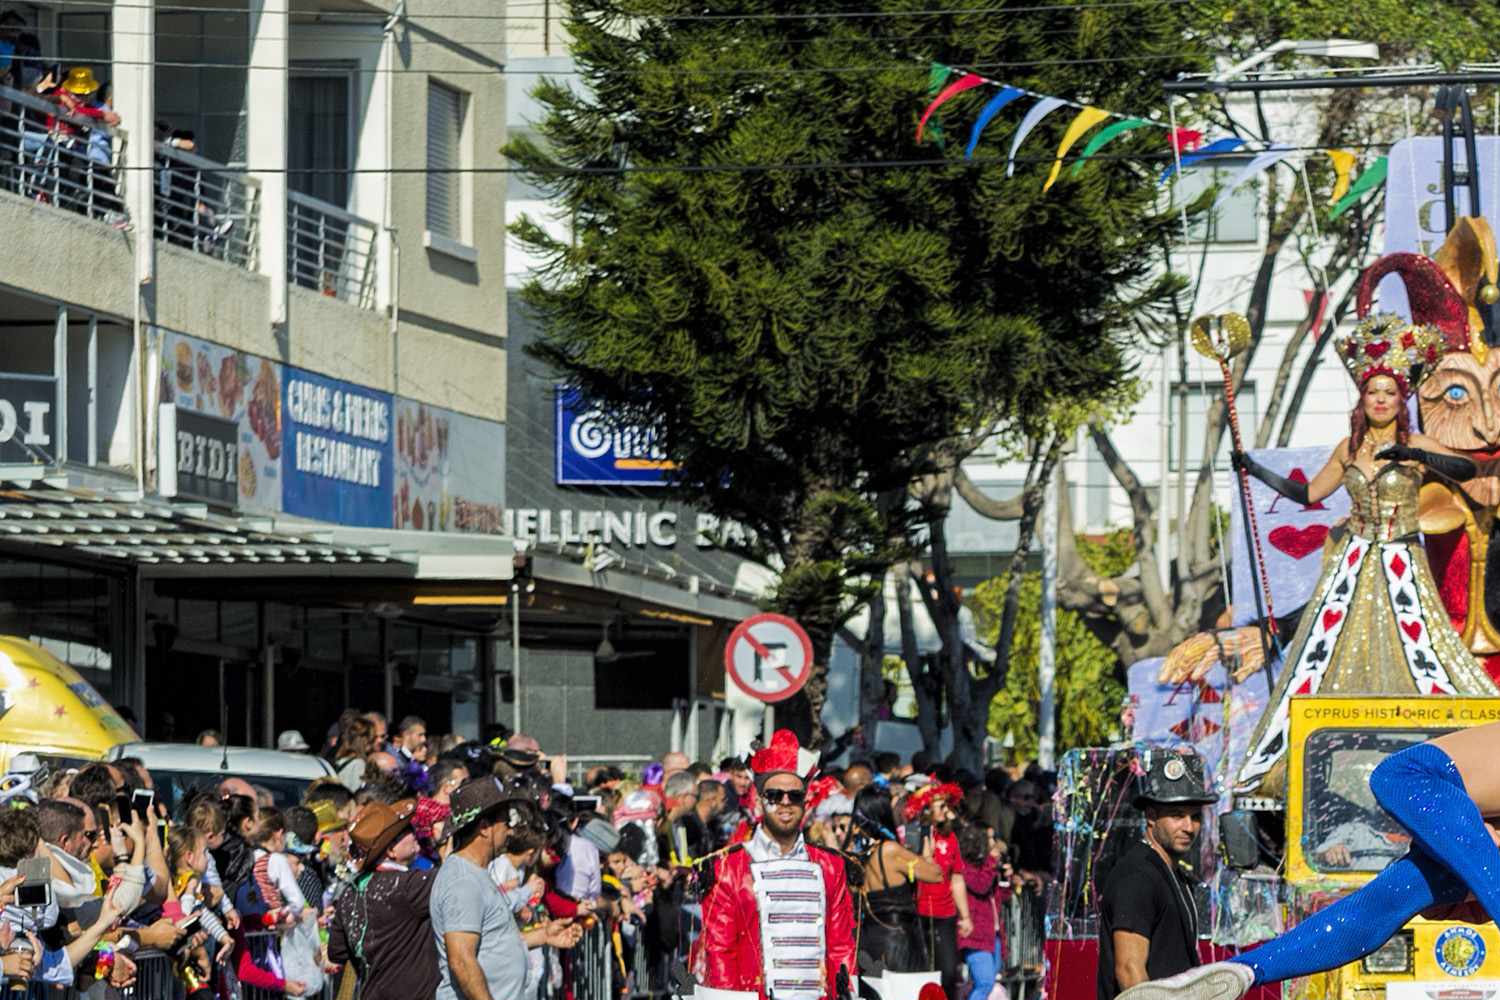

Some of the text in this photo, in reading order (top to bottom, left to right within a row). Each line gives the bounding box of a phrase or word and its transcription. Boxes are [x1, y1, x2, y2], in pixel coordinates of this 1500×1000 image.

[177, 430, 237, 483] BIDI
[1303, 707, 1360, 720] CYPRUS
[1364, 706, 1440, 720] HISTORIC
